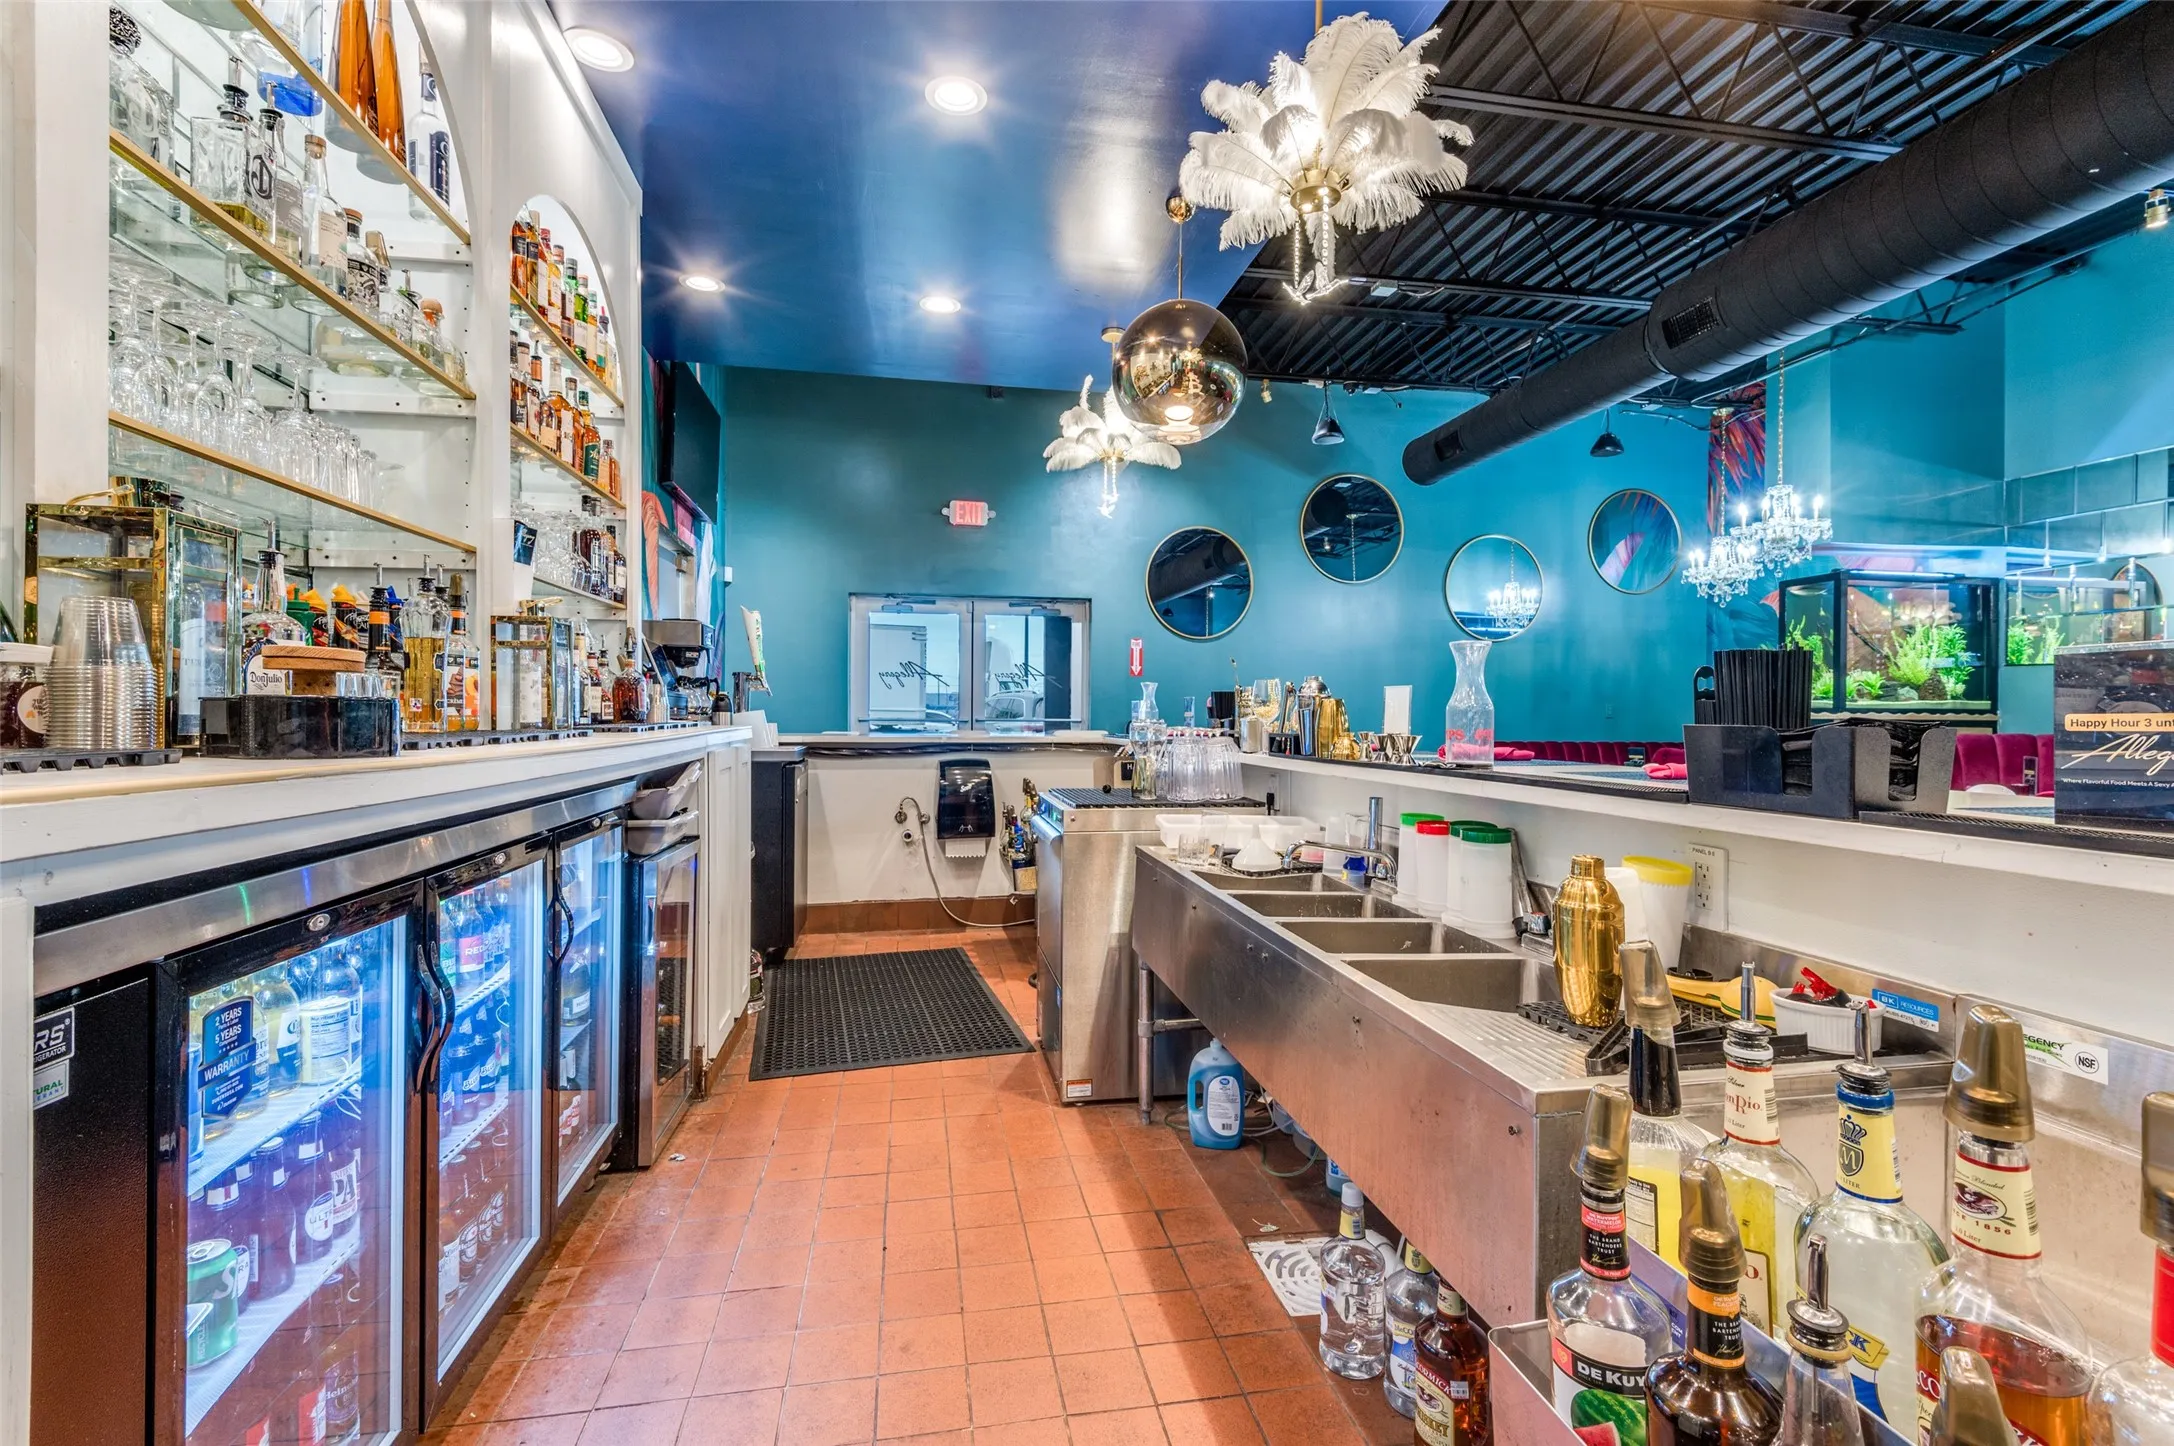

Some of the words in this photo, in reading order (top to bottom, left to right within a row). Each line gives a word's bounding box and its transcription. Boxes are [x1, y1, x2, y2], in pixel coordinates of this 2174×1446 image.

[955, 501, 984, 524] EXIT
[2070, 718, 2107, 729] Happy
[2110, 718, 2140, 728] Hour
[2144, 718, 2152, 728] 3
[2154, 781, 2170, 789] Sexy
[1881, 995, 1896, 1005] BK
[1900, 1000, 1935, 1016] RESOURCES
[215, 1016, 220, 1027] 2
[220, 1006, 242, 1024] YEARS
[34, 1023, 66, 1052] RS
[215, 1033, 220, 1044] 5
[220, 1024, 242, 1041] YEARS
[2023, 1034, 2065, 1051] EGENCY
[34, 1045, 66, 1062] IGERATOR
[204, 1049, 250, 1082] WARRANTY
[1589, 1233, 1600, 1241] THE
[1975, 1220, 2011, 1235] 1856
[1588, 1238, 1622, 1248] BARTENDERS
[1416, 1361, 1450, 1396] CORMICK
[1577, 1360, 1602, 1381] DE
[1605, 1371, 1645, 1387] KUY
